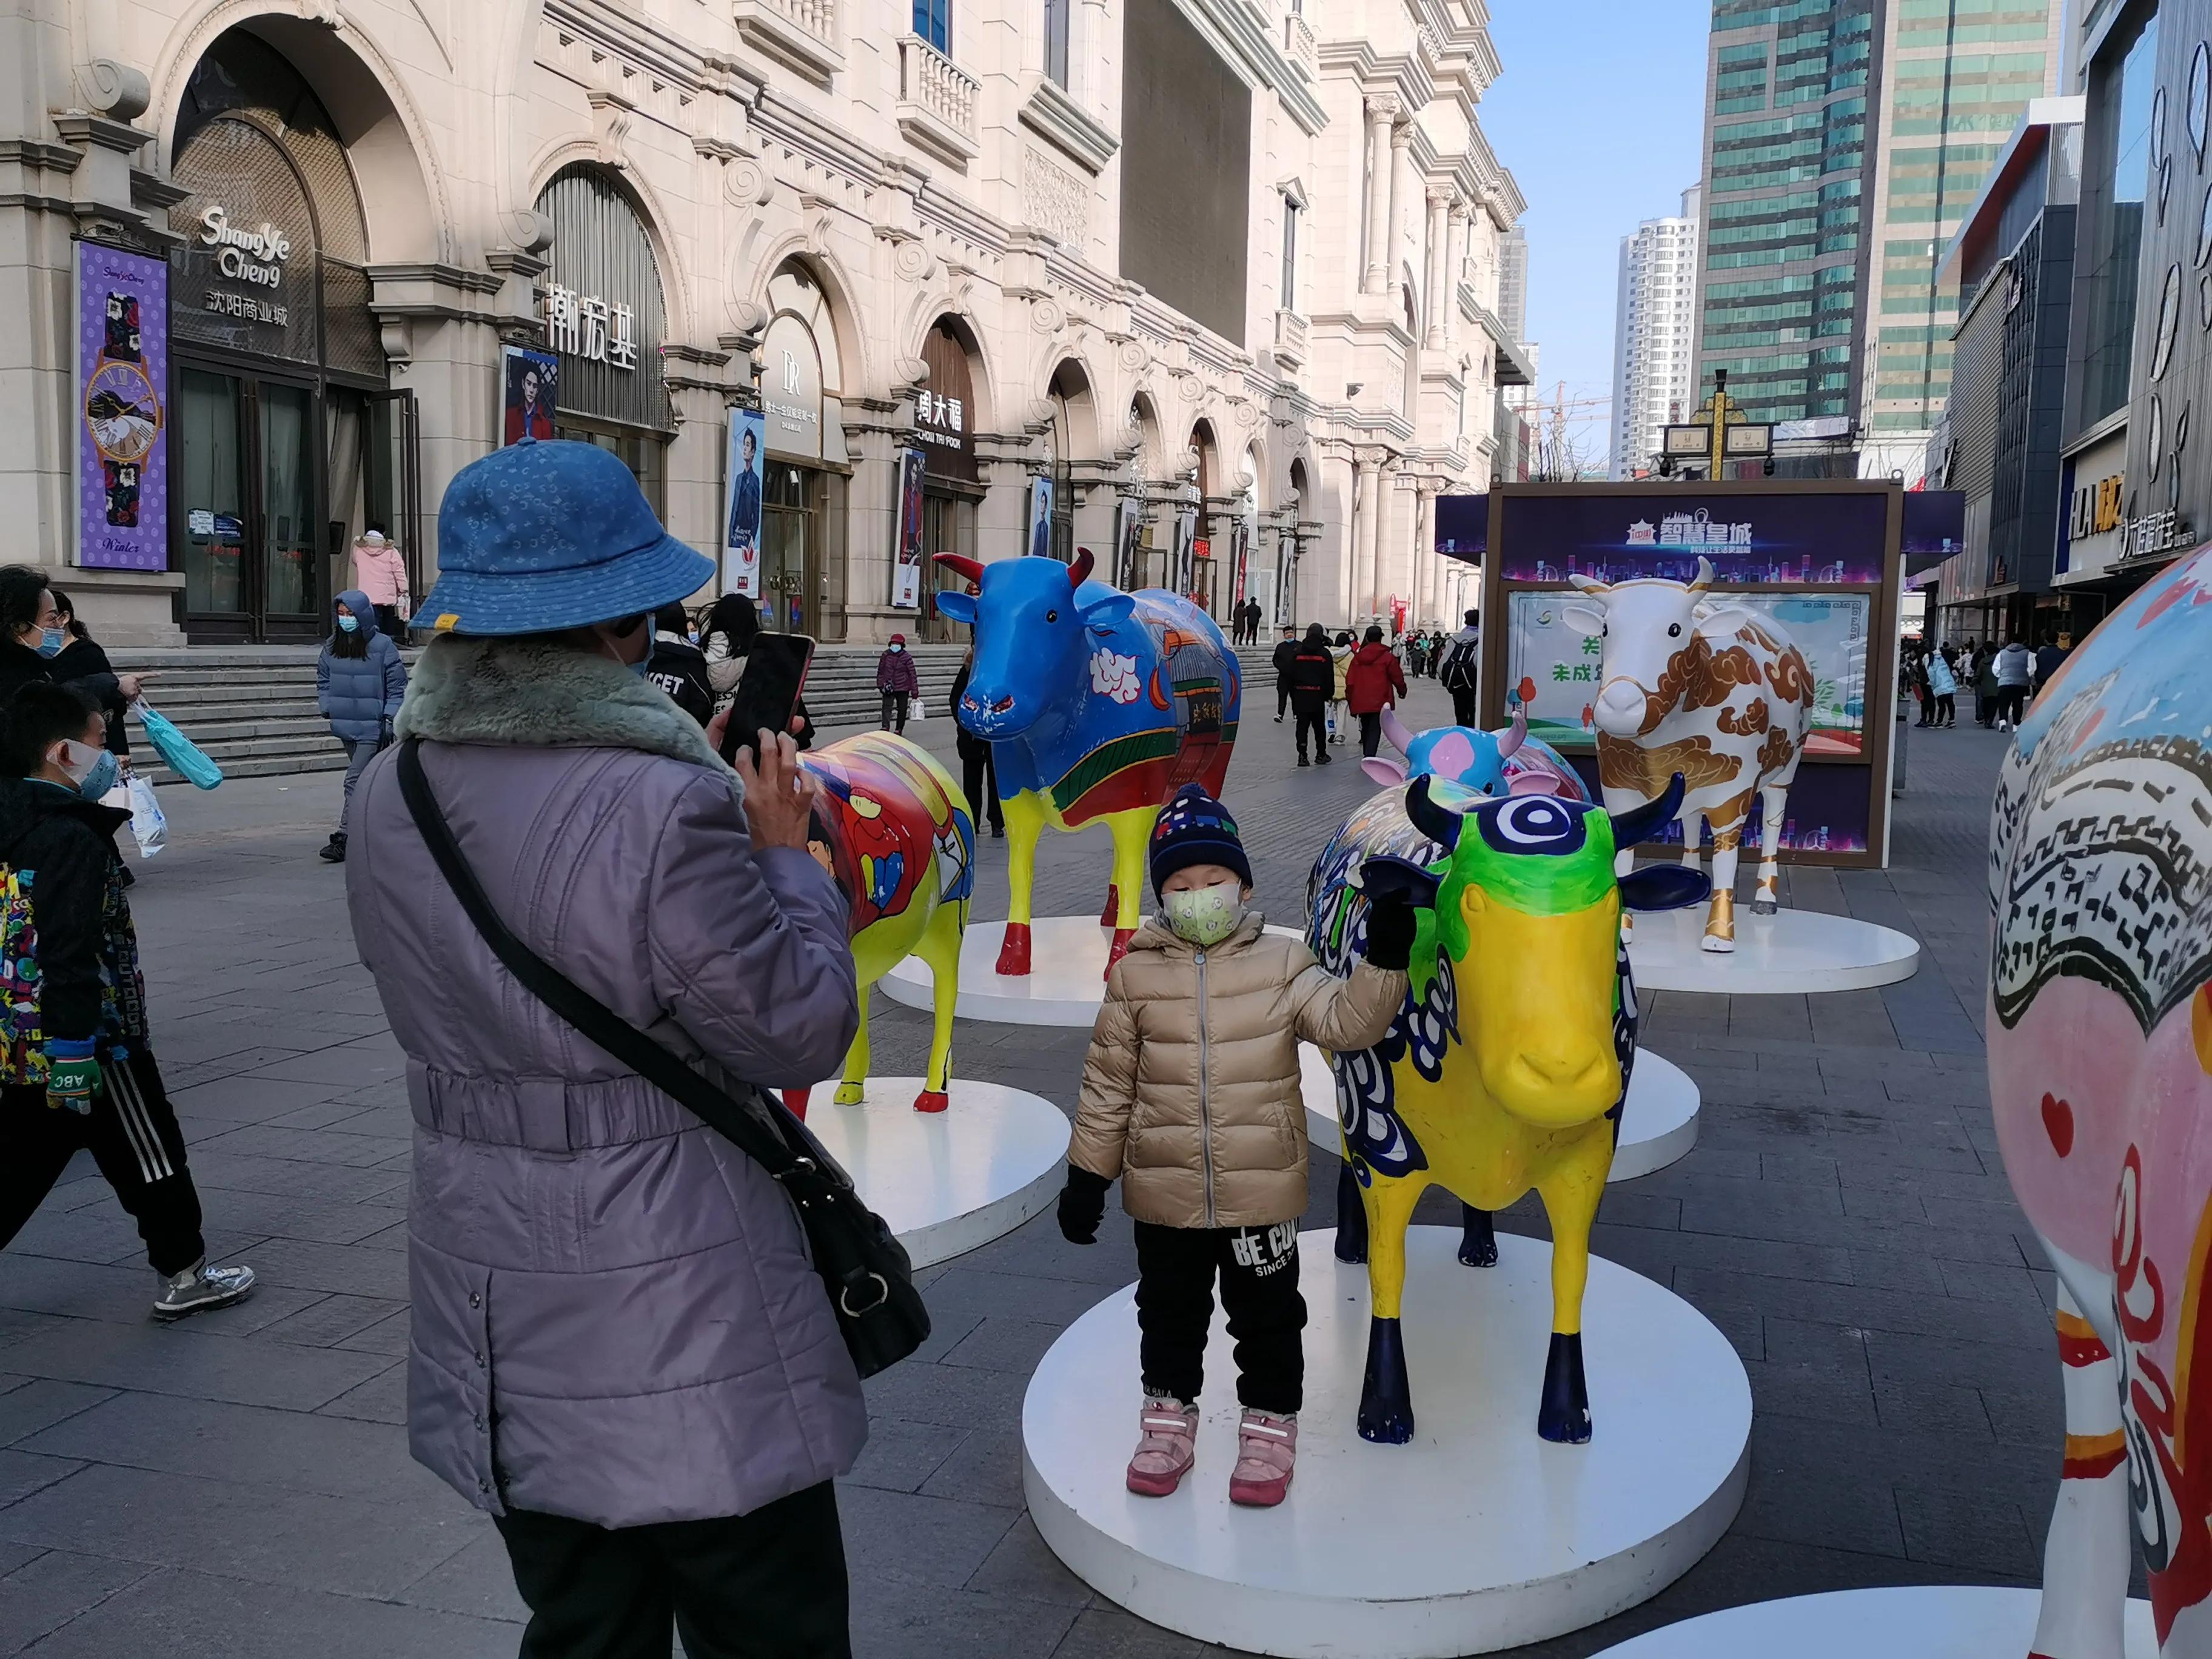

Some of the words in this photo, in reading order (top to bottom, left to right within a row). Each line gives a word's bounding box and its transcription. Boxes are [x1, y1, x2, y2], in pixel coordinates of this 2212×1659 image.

[220, 247, 280, 288] Cheng
[205, 290, 288, 327] 沈阳商业城
[547, 283, 637, 370] 潮宏基
[918, 390, 962, 432] 周大福
[2068, 484, 2093, 541] HLA
[102, 537, 139, 553] Winter
[1660, 522, 1752, 545] 智慧皇城
[55, 1074, 85, 1088] ABC
[1232, 1233, 1268, 1266] BE
[1255, 1255, 1287, 1277] SINCE
